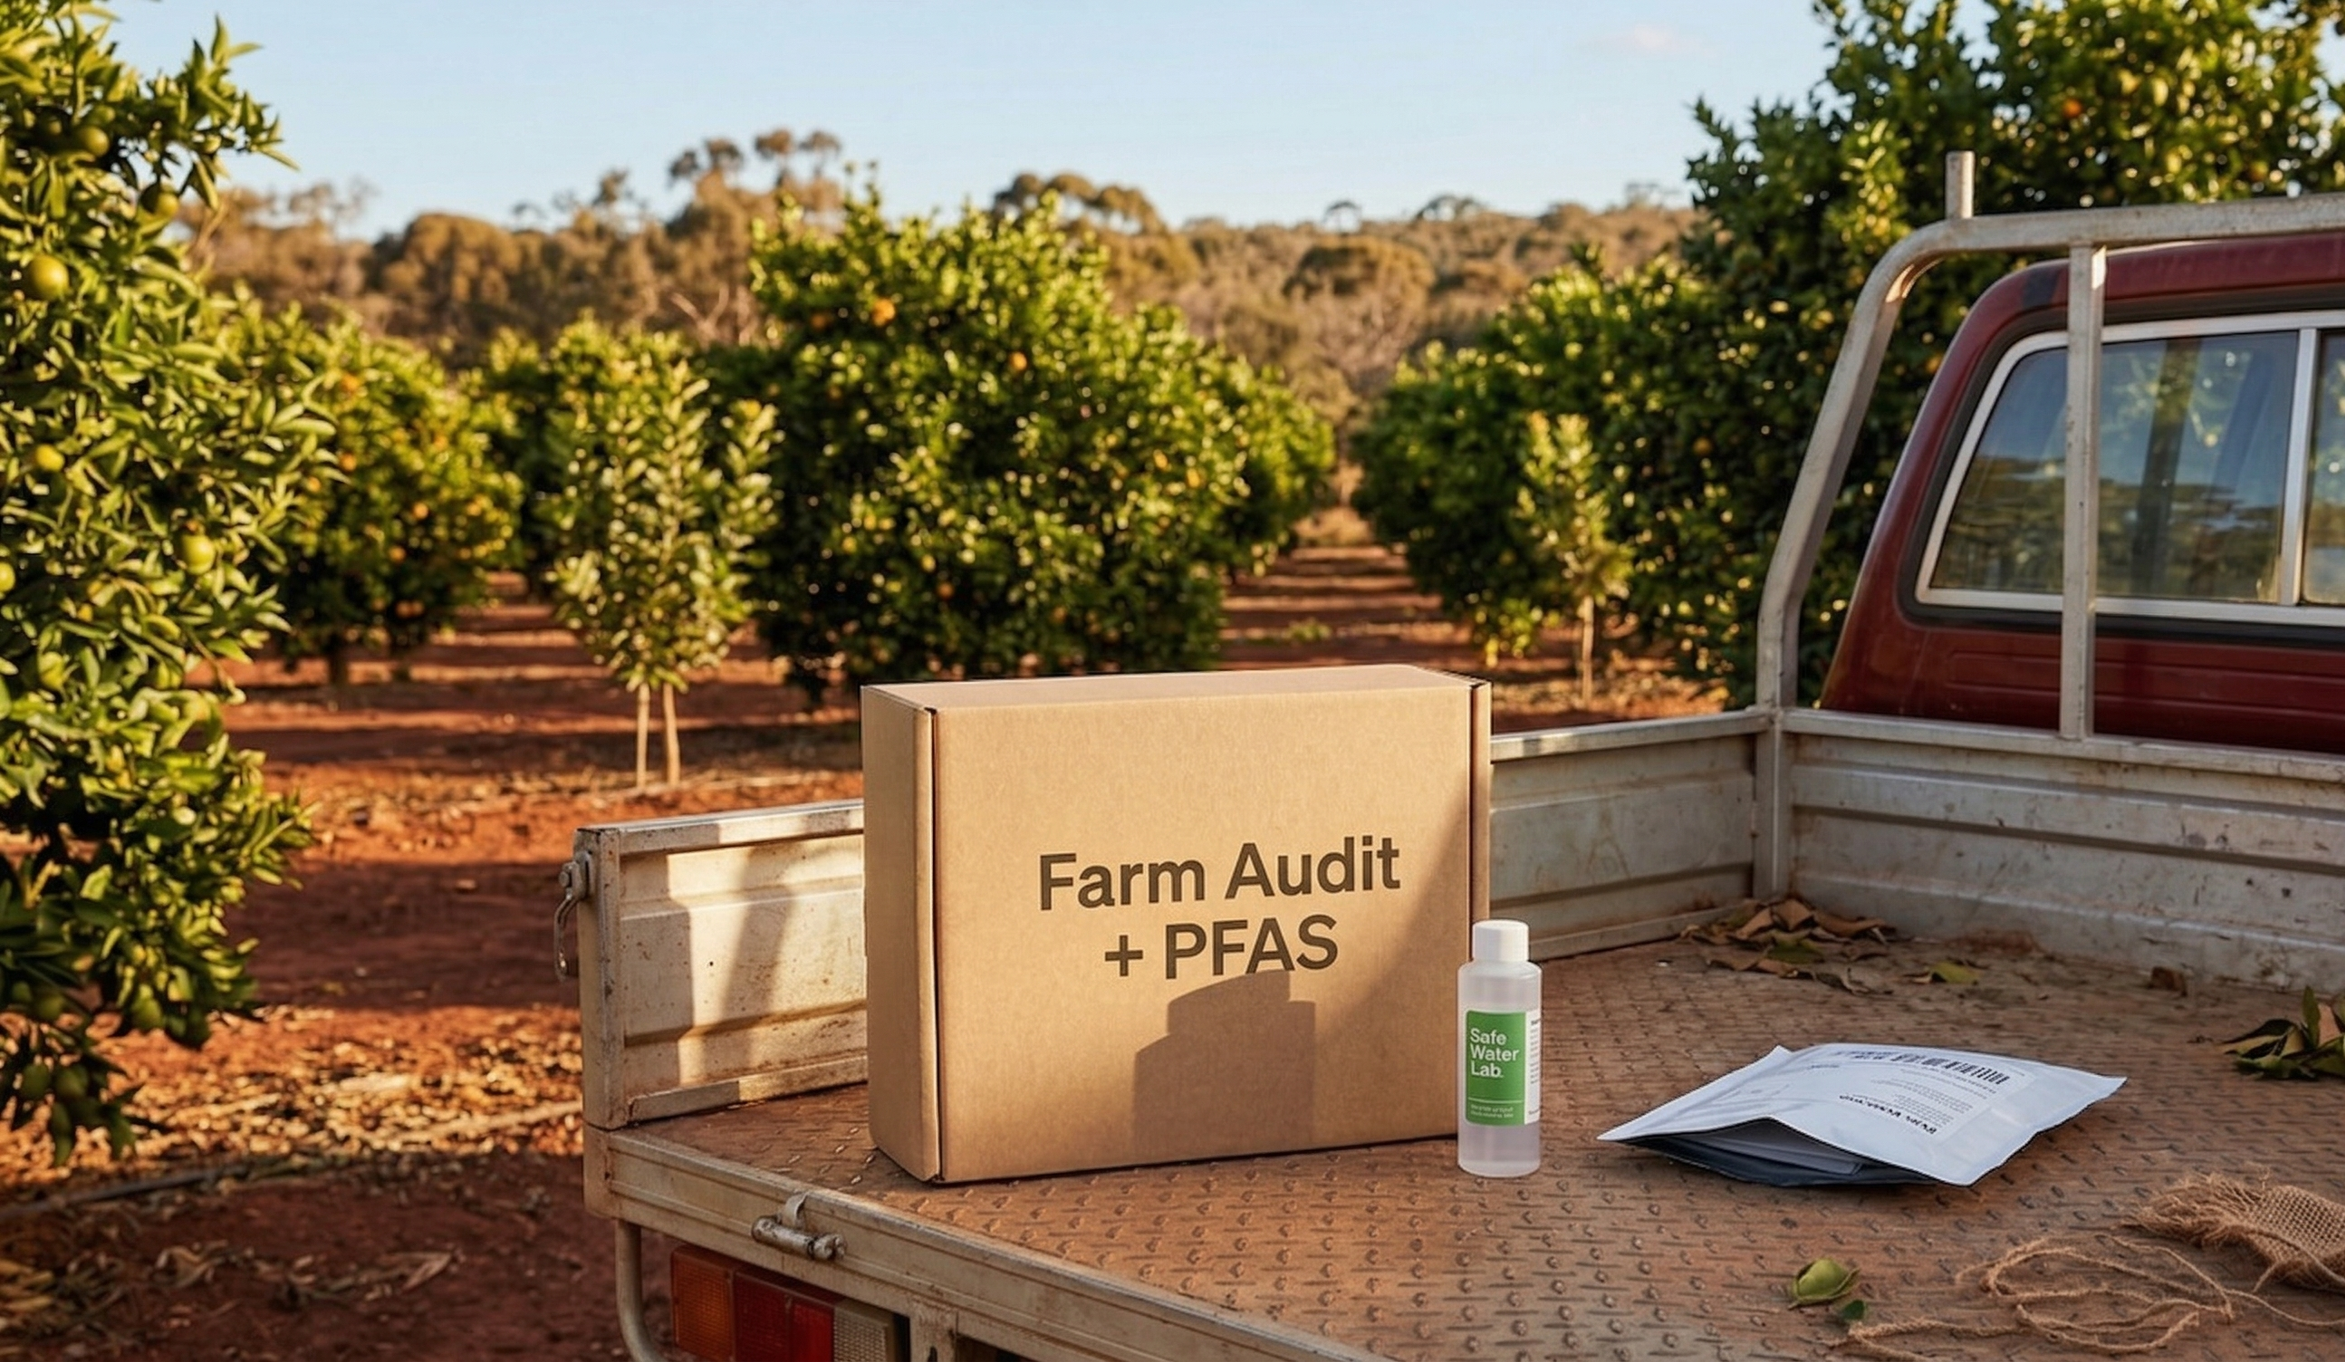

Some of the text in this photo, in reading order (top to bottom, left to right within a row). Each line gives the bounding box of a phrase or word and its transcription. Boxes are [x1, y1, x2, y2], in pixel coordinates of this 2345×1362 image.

[1039, 835, 1401, 911] Farm Audit
[1104, 914, 1339, 980] + PFAS
[1470, 1028, 1507, 1045] Safe
[1470, 1043, 1520, 1062] Water
